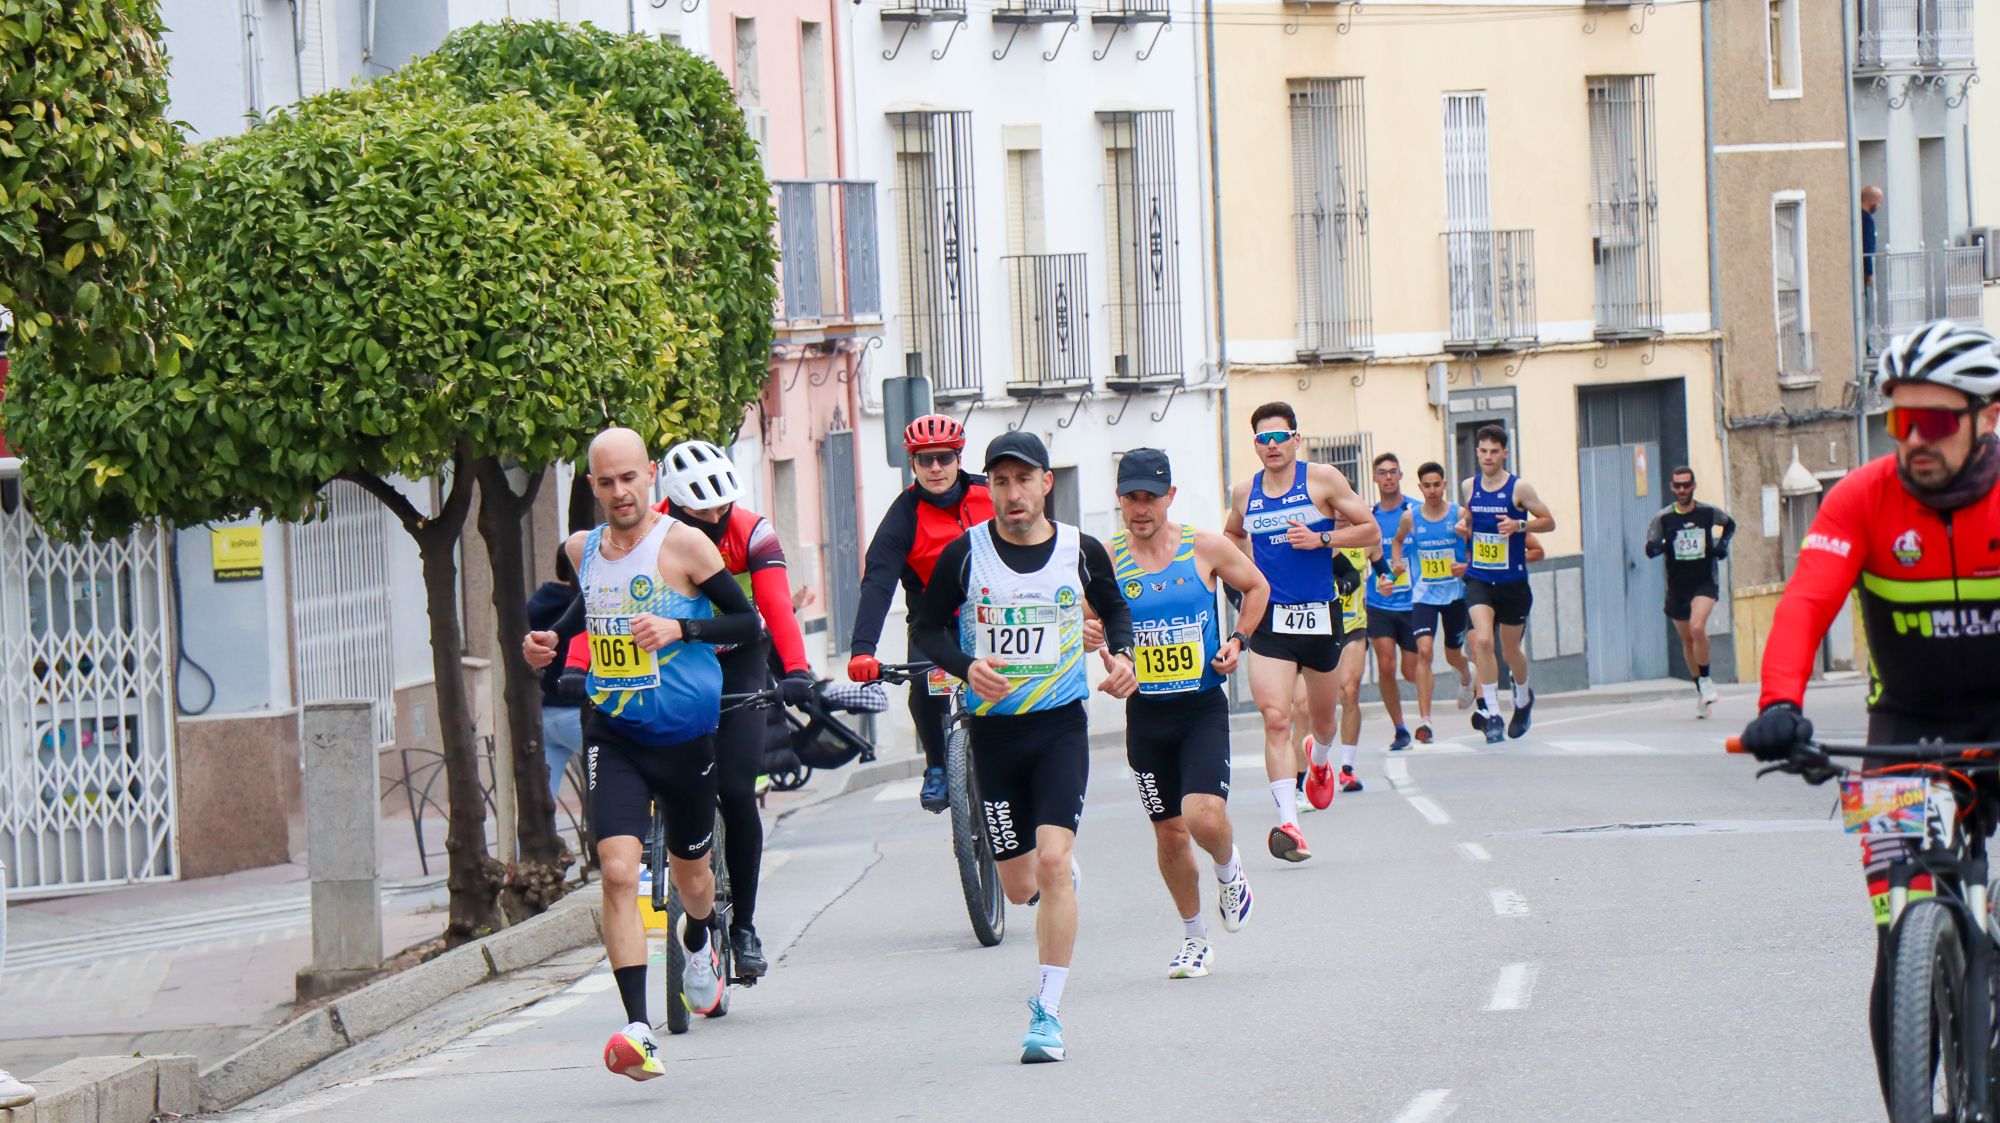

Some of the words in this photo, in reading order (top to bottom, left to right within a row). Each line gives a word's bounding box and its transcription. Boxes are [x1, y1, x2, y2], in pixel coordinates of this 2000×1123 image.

[1479, 545, 1498, 558] 393
[1679, 540, 1698, 551] 234
[1425, 560, 1445, 573] 731
[1285, 611, 1316, 629] 476
[592, 638, 641, 668] 1061
[987, 626, 1045, 655] 1207
[1142, 645, 1194, 674] 1359
[1141, 772, 1166, 814] SURCO
[983, 800, 1005, 855] LUCENA
[994, 800, 1020, 851] SURCO
